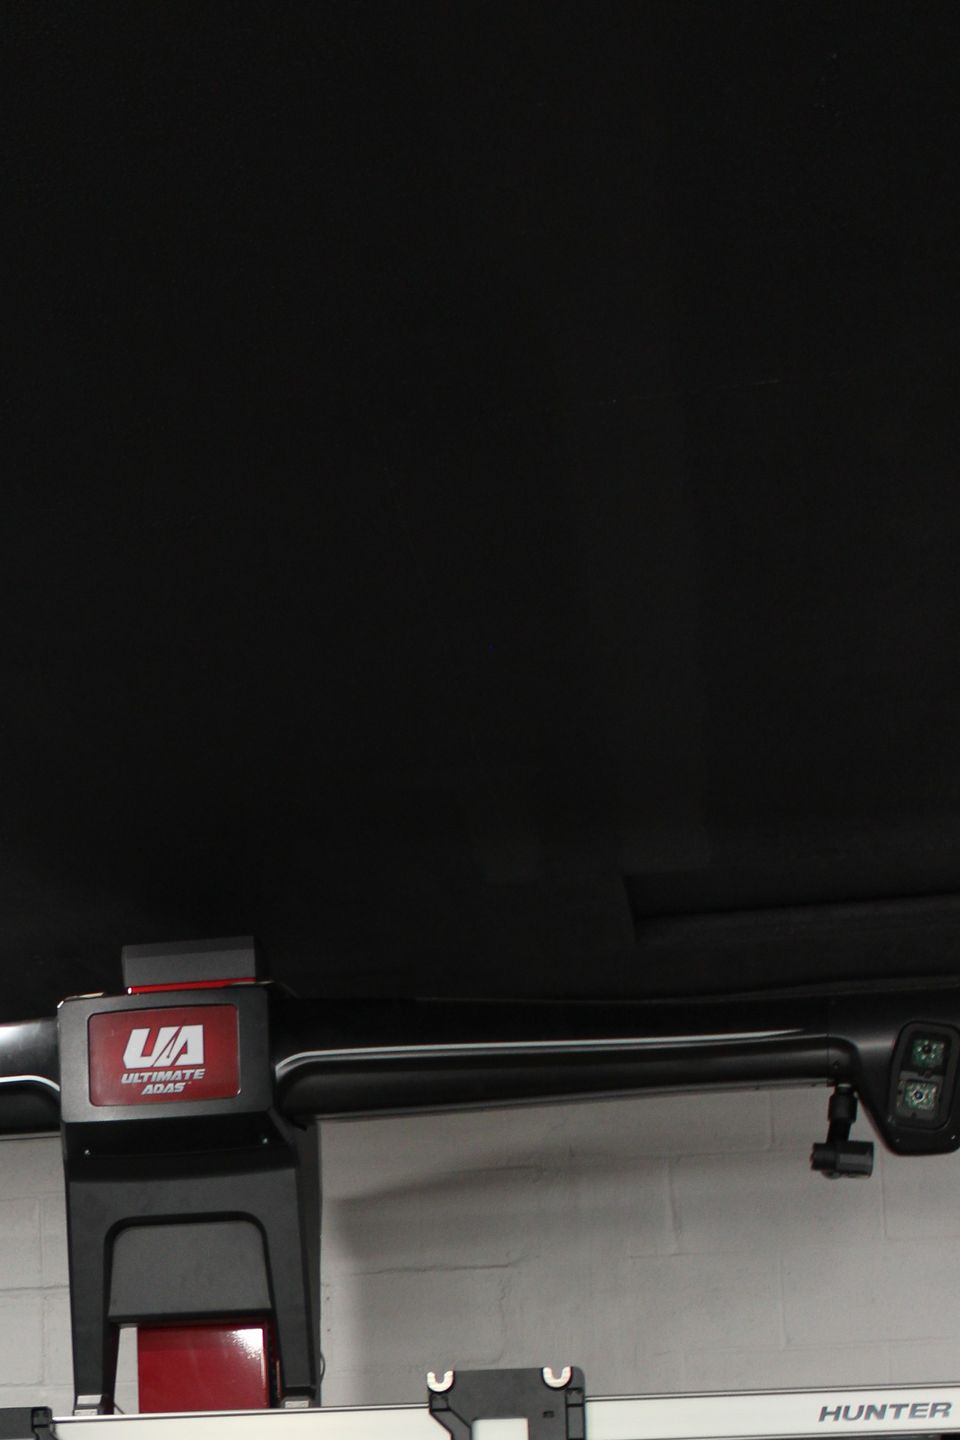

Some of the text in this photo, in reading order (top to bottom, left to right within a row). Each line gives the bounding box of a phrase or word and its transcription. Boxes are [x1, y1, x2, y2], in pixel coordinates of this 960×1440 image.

[122, 1024, 205, 1069] UA
[120, 1067, 206, 1084] ULTIMATE
[140, 1081, 185, 1095] ADAS
[818, 1402, 952, 1422] HUNTER
